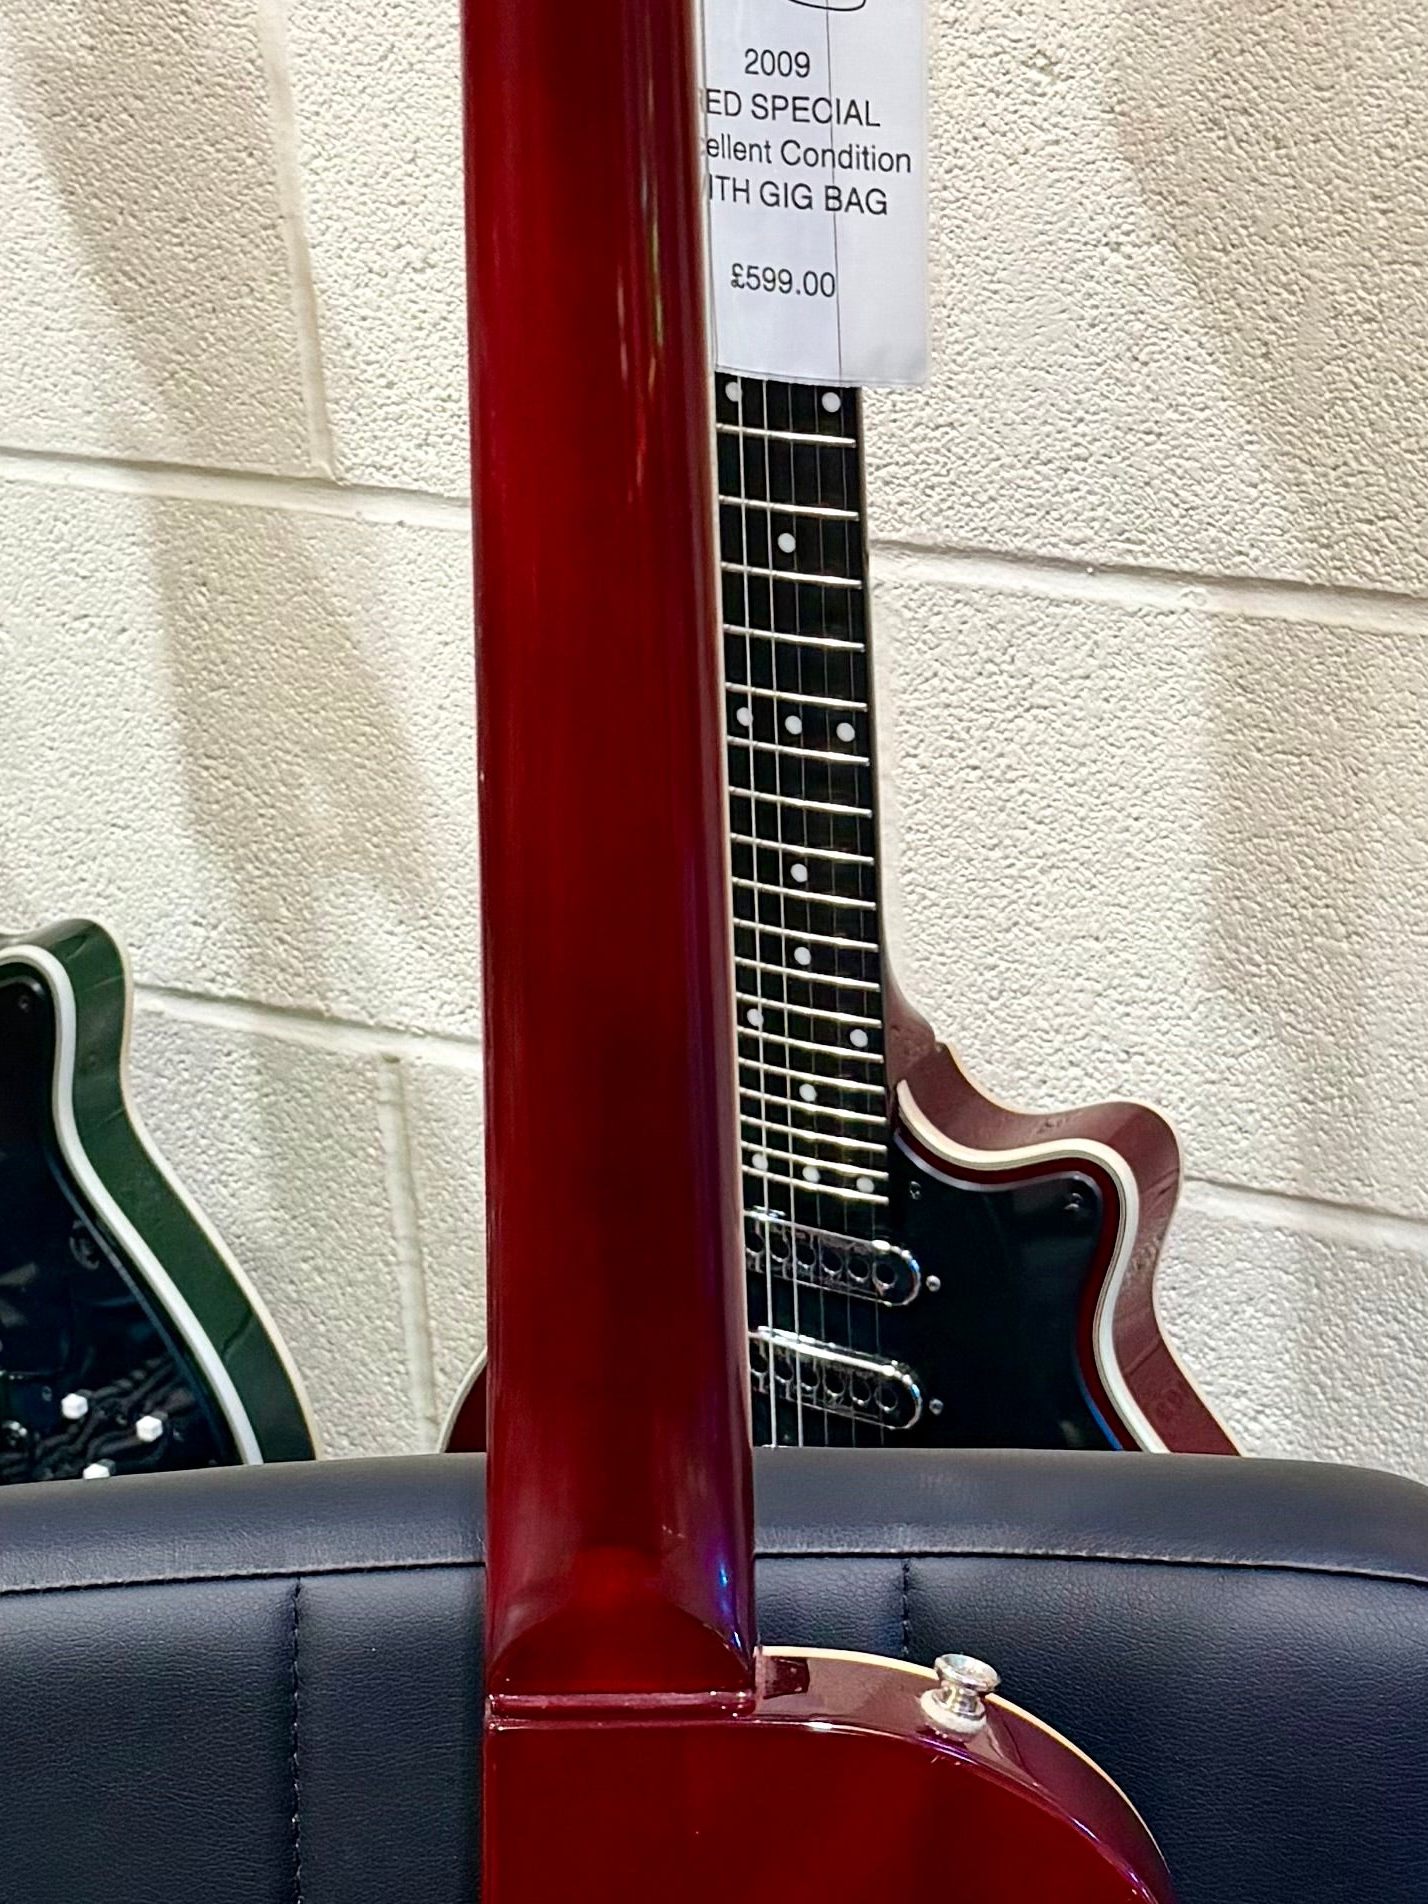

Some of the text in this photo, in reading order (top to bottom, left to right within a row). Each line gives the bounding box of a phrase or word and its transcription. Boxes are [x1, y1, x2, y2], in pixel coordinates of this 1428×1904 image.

[744, 48, 811, 79] 2009
[705, 87, 881, 128] ED SPECIAL
[706, 132, 912, 173] ellent Condition
[708, 173, 888, 216] ITH GIG BAG
[730, 262, 836, 298] £599.00
